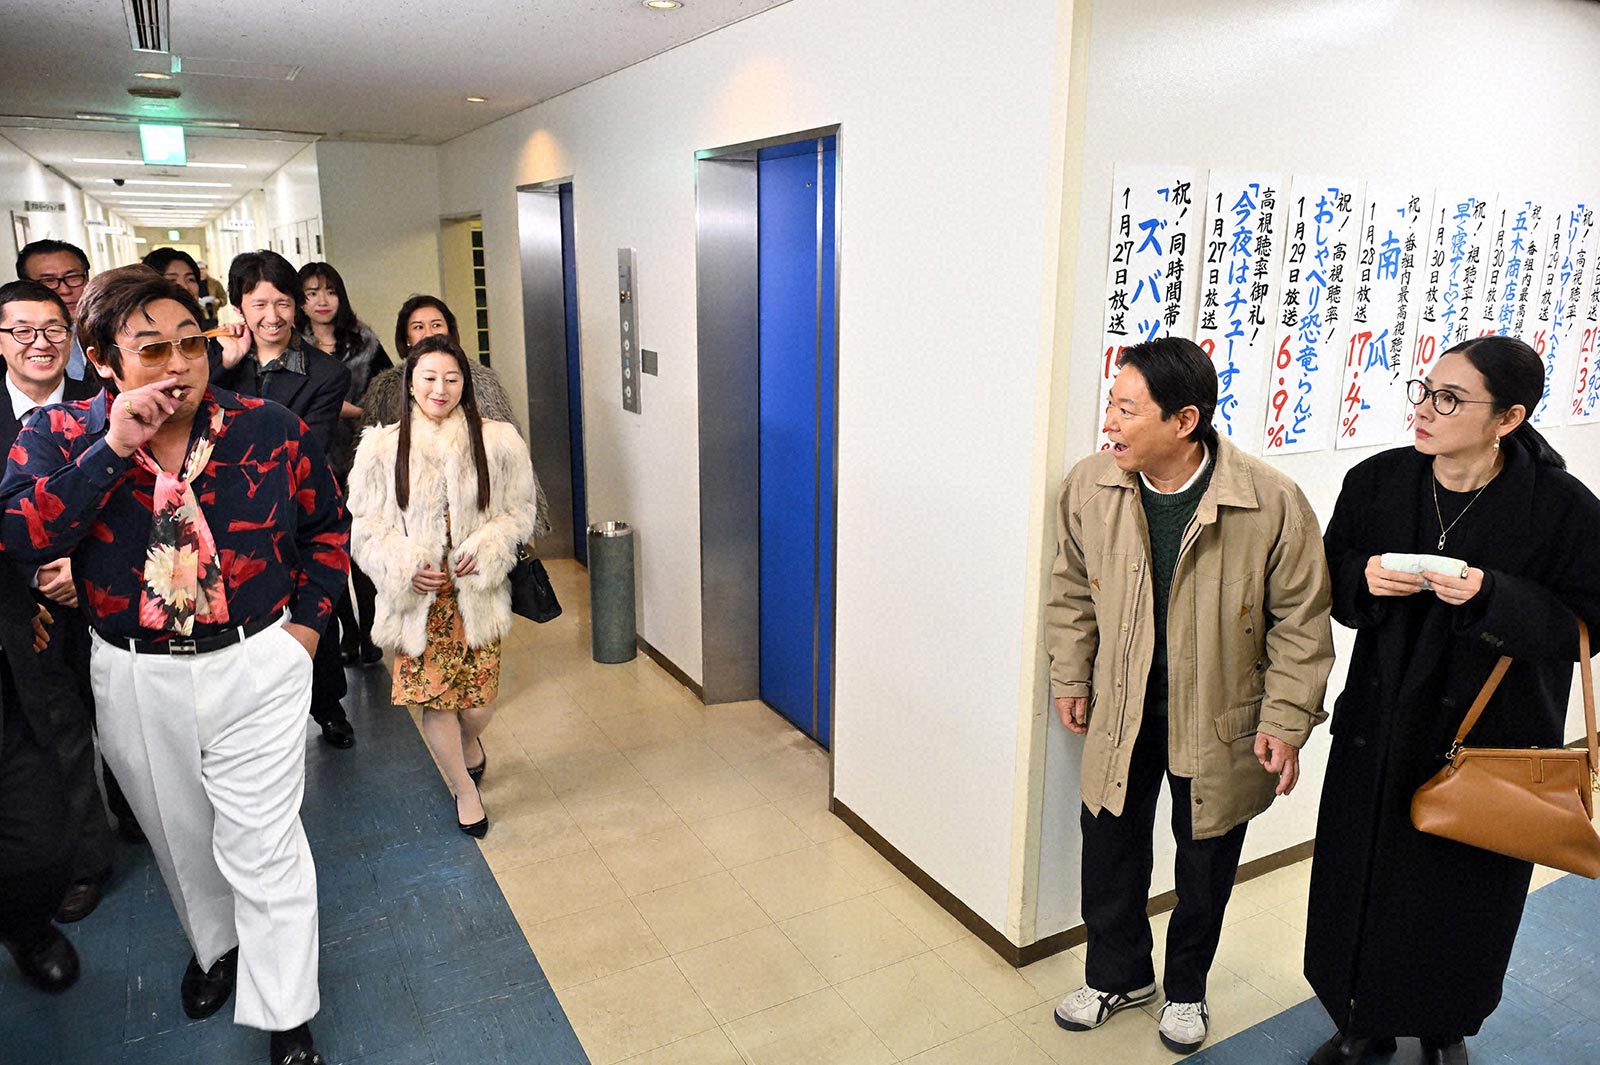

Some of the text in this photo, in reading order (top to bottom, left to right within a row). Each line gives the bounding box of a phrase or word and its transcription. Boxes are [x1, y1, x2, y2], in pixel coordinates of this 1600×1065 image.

[1107, 188, 1134, 336] 1月27日放送
[1163, 180, 1191, 341] 祝！同時間帯
[1201, 192, 1227, 330] 1月27日放送
[1247, 187, 1276, 347] 高視聴率御礼！
[1282, 197, 1307, 327] 1月29日放送
[1285, 187, 1339, 444] 「おしゃべり恐竜らんど」
[1353, 202, 1376, 323] 1月28日放送
[1389, 195, 1421, 386] 祝！番組内最高視聴率！
[1422, 208, 1446, 323] 1月30日放送
[1482, 209, 1507, 322] 1月30日放送
[1538, 214, 1562, 322] 1月29日放送
